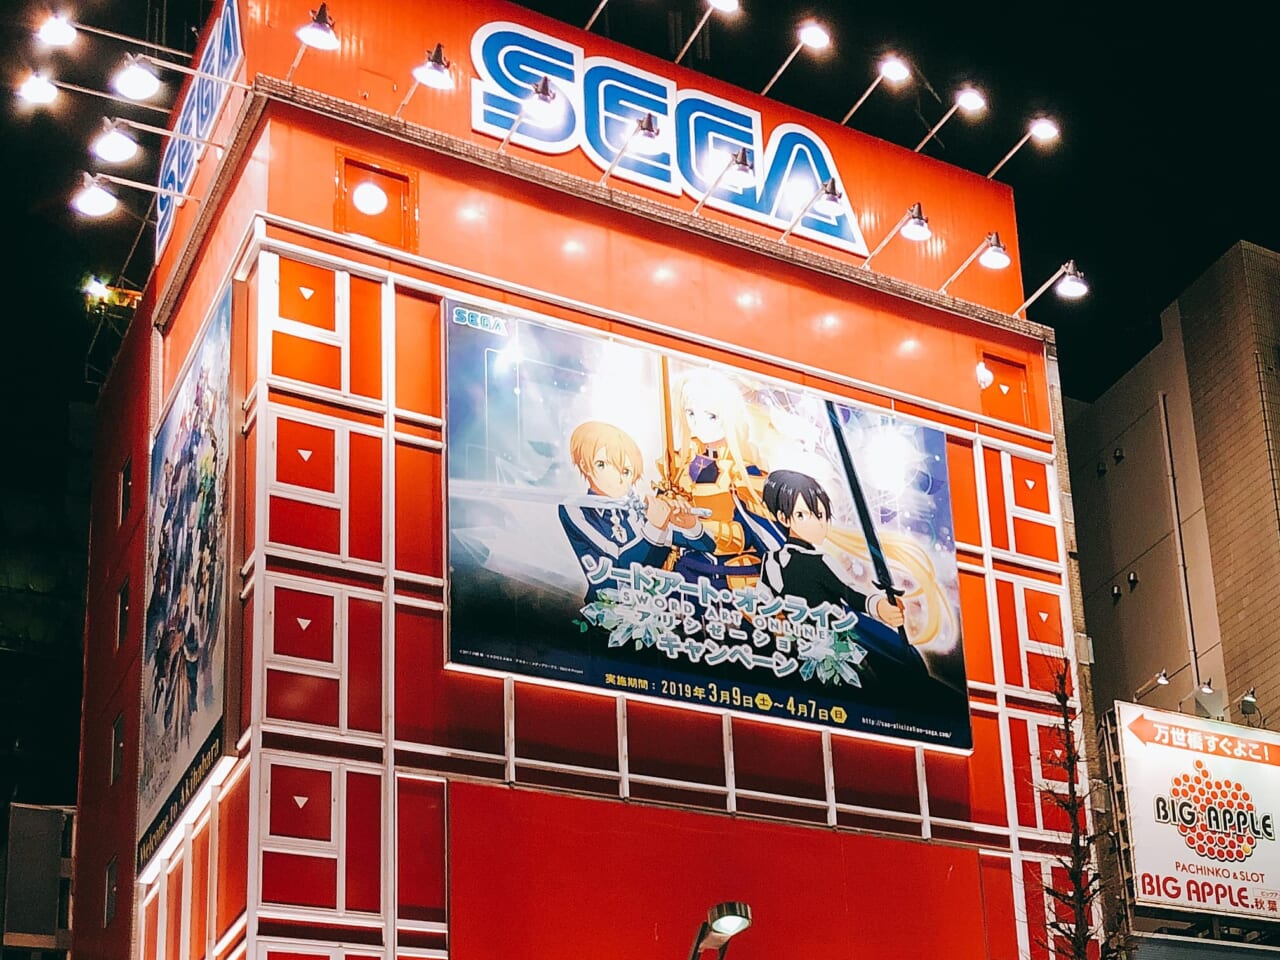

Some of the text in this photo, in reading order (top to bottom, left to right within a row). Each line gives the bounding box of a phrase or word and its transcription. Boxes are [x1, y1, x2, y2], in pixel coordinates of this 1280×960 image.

[470, 21, 871, 257] SEGA
[452, 307, 508, 337] SEGA
[581, 553, 859, 633] ソードアート・オンライン
[623, 590, 827, 640] SWORD ART ONLINE
[634, 610, 815, 653] アリシゼーション
[658, 632, 801, 678] キャンペーン
[1153, 721, 1270, 762] 万世橋すぐよこ!
[140, 738, 220, 861] Welcome to Akihabara
[1156, 797, 1276, 840] BIG APPLE
[1141, 872, 1182, 898] BIG
[1175, 861, 1230, 881] PACHINKO
[1240, 871, 1266, 884] SLOT
